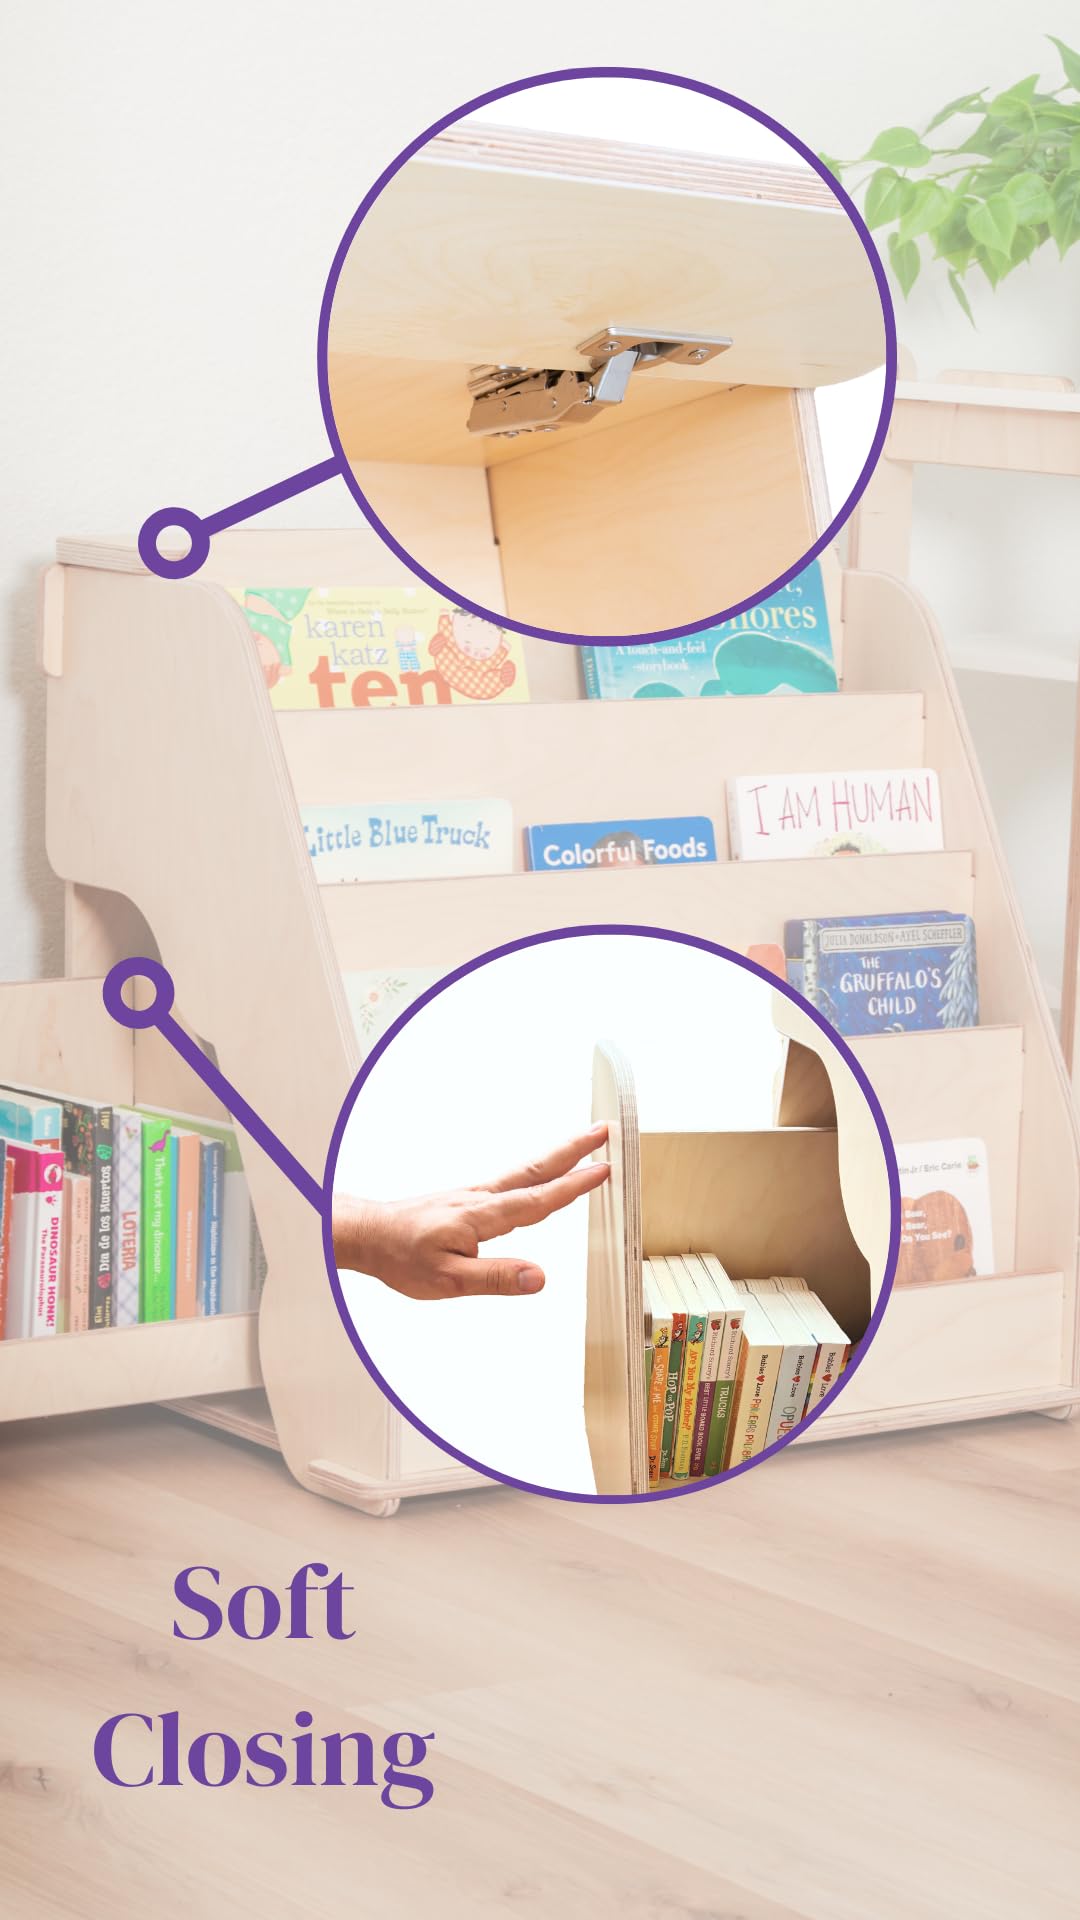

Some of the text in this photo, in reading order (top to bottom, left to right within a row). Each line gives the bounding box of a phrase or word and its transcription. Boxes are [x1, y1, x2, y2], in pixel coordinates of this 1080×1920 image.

[304, 614, 385, 639] karen
[330, 641, 389, 666] katz
[309, 655, 452, 708] ten
[748, 776, 933, 835] I AM HUMAN
[368, 817, 418, 848] Blue
[421, 814, 491, 849] Truck
[543, 837, 708, 866] Colorful Foods
[859, 956, 881, 969] THE
[840, 967, 942, 993] GRUFFALO'S
[868, 996, 917, 1016] CHILD
[154, 1156, 165, 1185] That's
[100, 1165, 112, 1212] Muertos
[154, 1188, 164, 1210] not
[100, 1215, 111, 1233] los
[151, 1211, 161, 1228] my
[99, 1235, 111, 1249] de
[122, 1211, 137, 1271] LOTERIA
[46, 1217, 59, 1328] DINOSAUR HONK!
[709, 1331, 719, 1355] Richard
[728, 1330, 738, 1354] Richard
[653, 1364, 664, 1385] SHAPE
[758, 1354, 769, 1375] Babies
[825, 1352, 838, 1373] Babies
[666, 1371, 678, 1393] HOP
[789, 1355, 805, 1397] Babies Love
[653, 1393, 662, 1403] ME
[682, 1349, 698, 1430] Are You My Mother?
[703, 1383, 711, 1395] BEST
[754, 1382, 763, 1397] Love
[664, 1402, 676, 1422] POP
[717, 1386, 729, 1418] TRUCKS
[698, 1413, 707, 1431] BOARD
